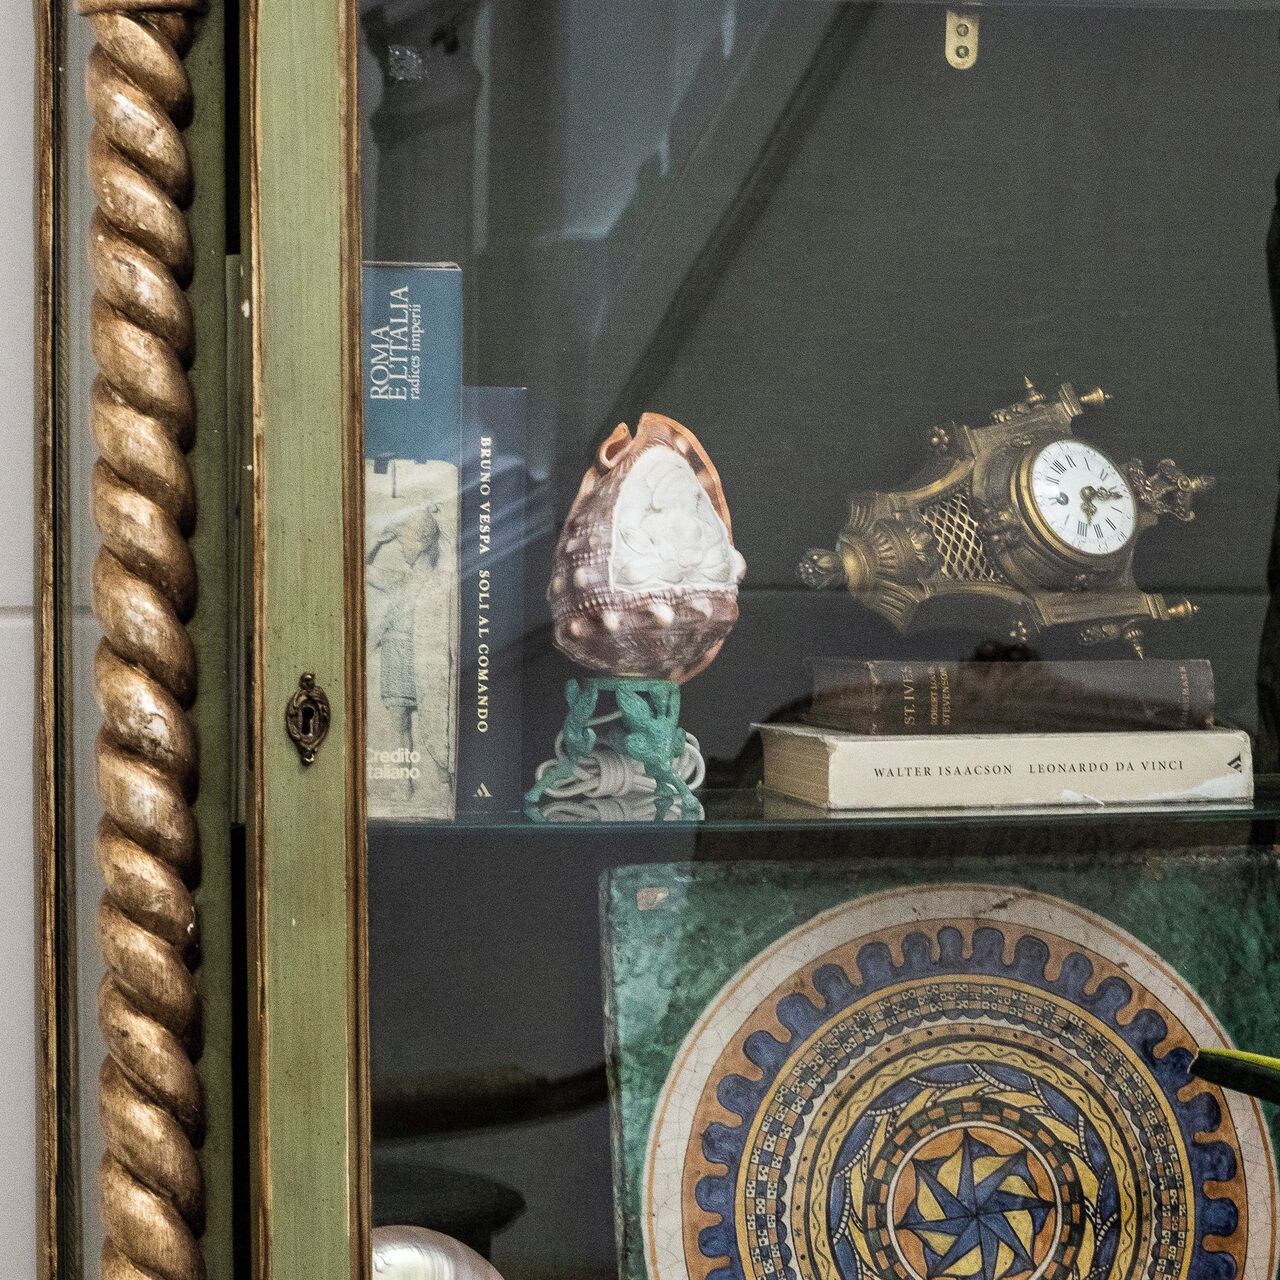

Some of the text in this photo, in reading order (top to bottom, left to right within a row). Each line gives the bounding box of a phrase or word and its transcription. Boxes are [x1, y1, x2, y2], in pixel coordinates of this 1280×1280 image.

[370, 326, 390, 400] ROMA
[388, 286, 409, 400] E L'ITALIA
[407, 355, 420, 400] radices
[479, 436, 492, 554] BRUNO VESPA
[477, 570, 490, 734] SOLI AL COMANDO
[902, 665, 915, 700] IVES
[938, 663, 951, 726] STEVENSON
[366, 764, 421, 780] taliano
[873, 760, 1184, 777] WALTER ISAACSON LEONARDO DA VINCI
